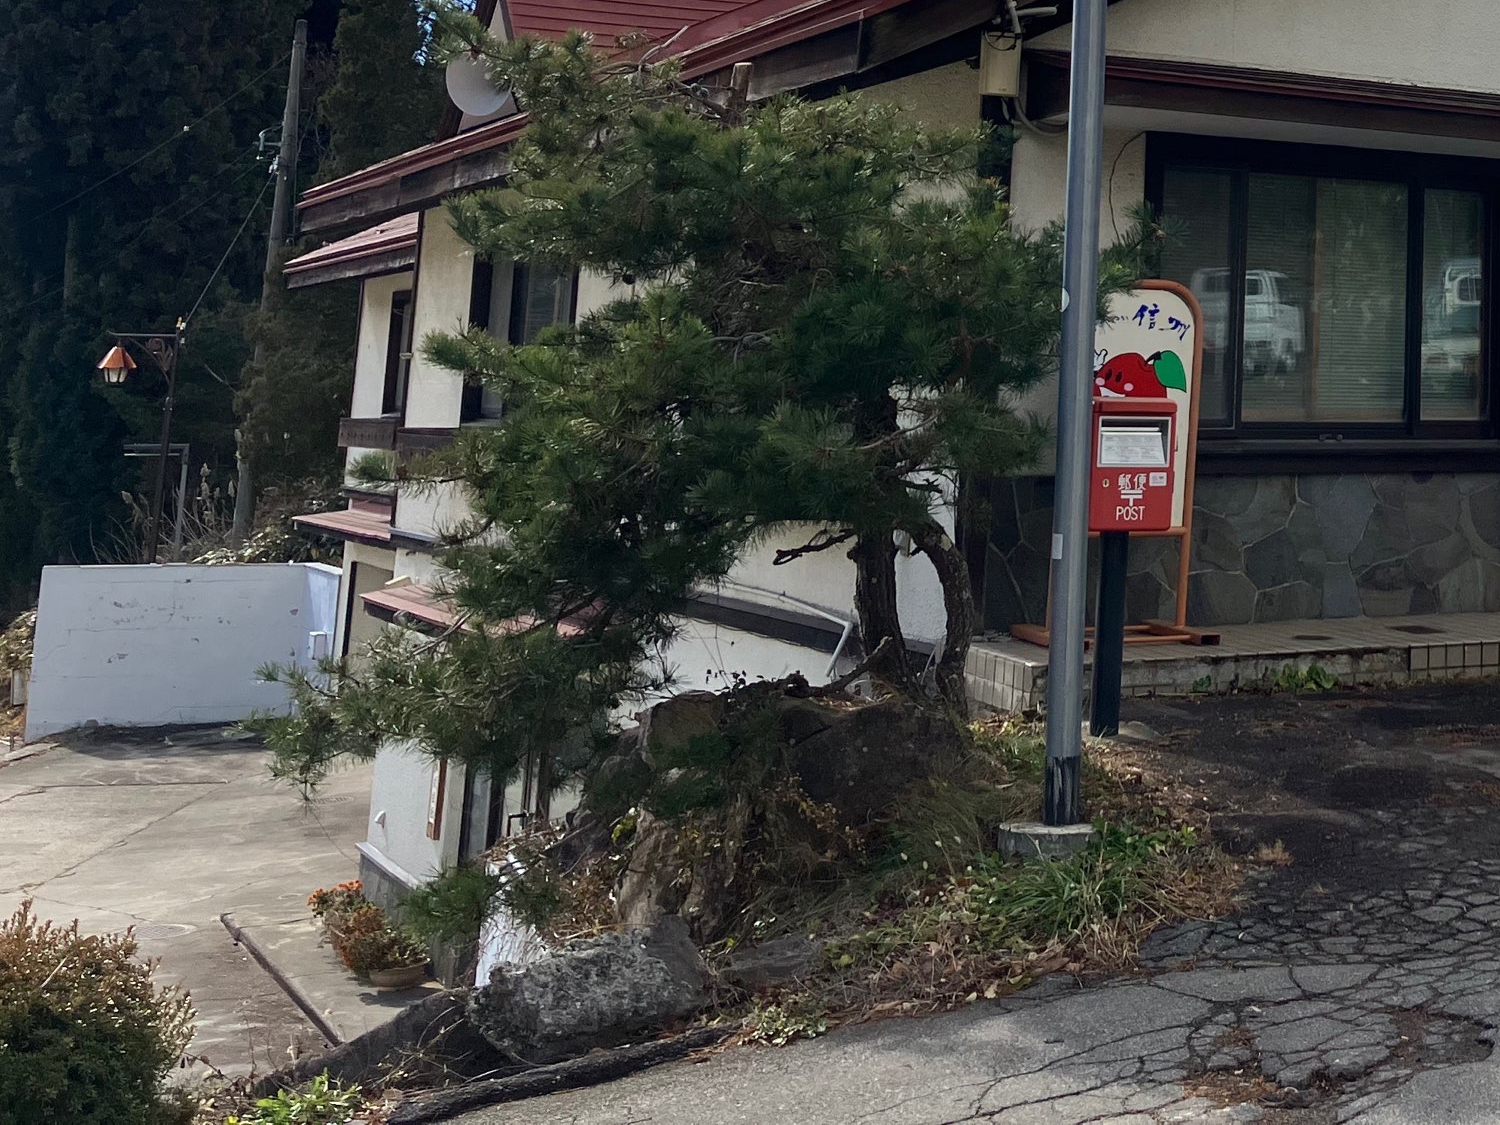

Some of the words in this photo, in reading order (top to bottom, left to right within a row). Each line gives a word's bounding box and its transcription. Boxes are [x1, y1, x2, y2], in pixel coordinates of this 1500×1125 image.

[1132, 303, 1191, 341] 信州
[1118, 473, 1147, 491] 郵便
[1116, 506, 1146, 521] POST
